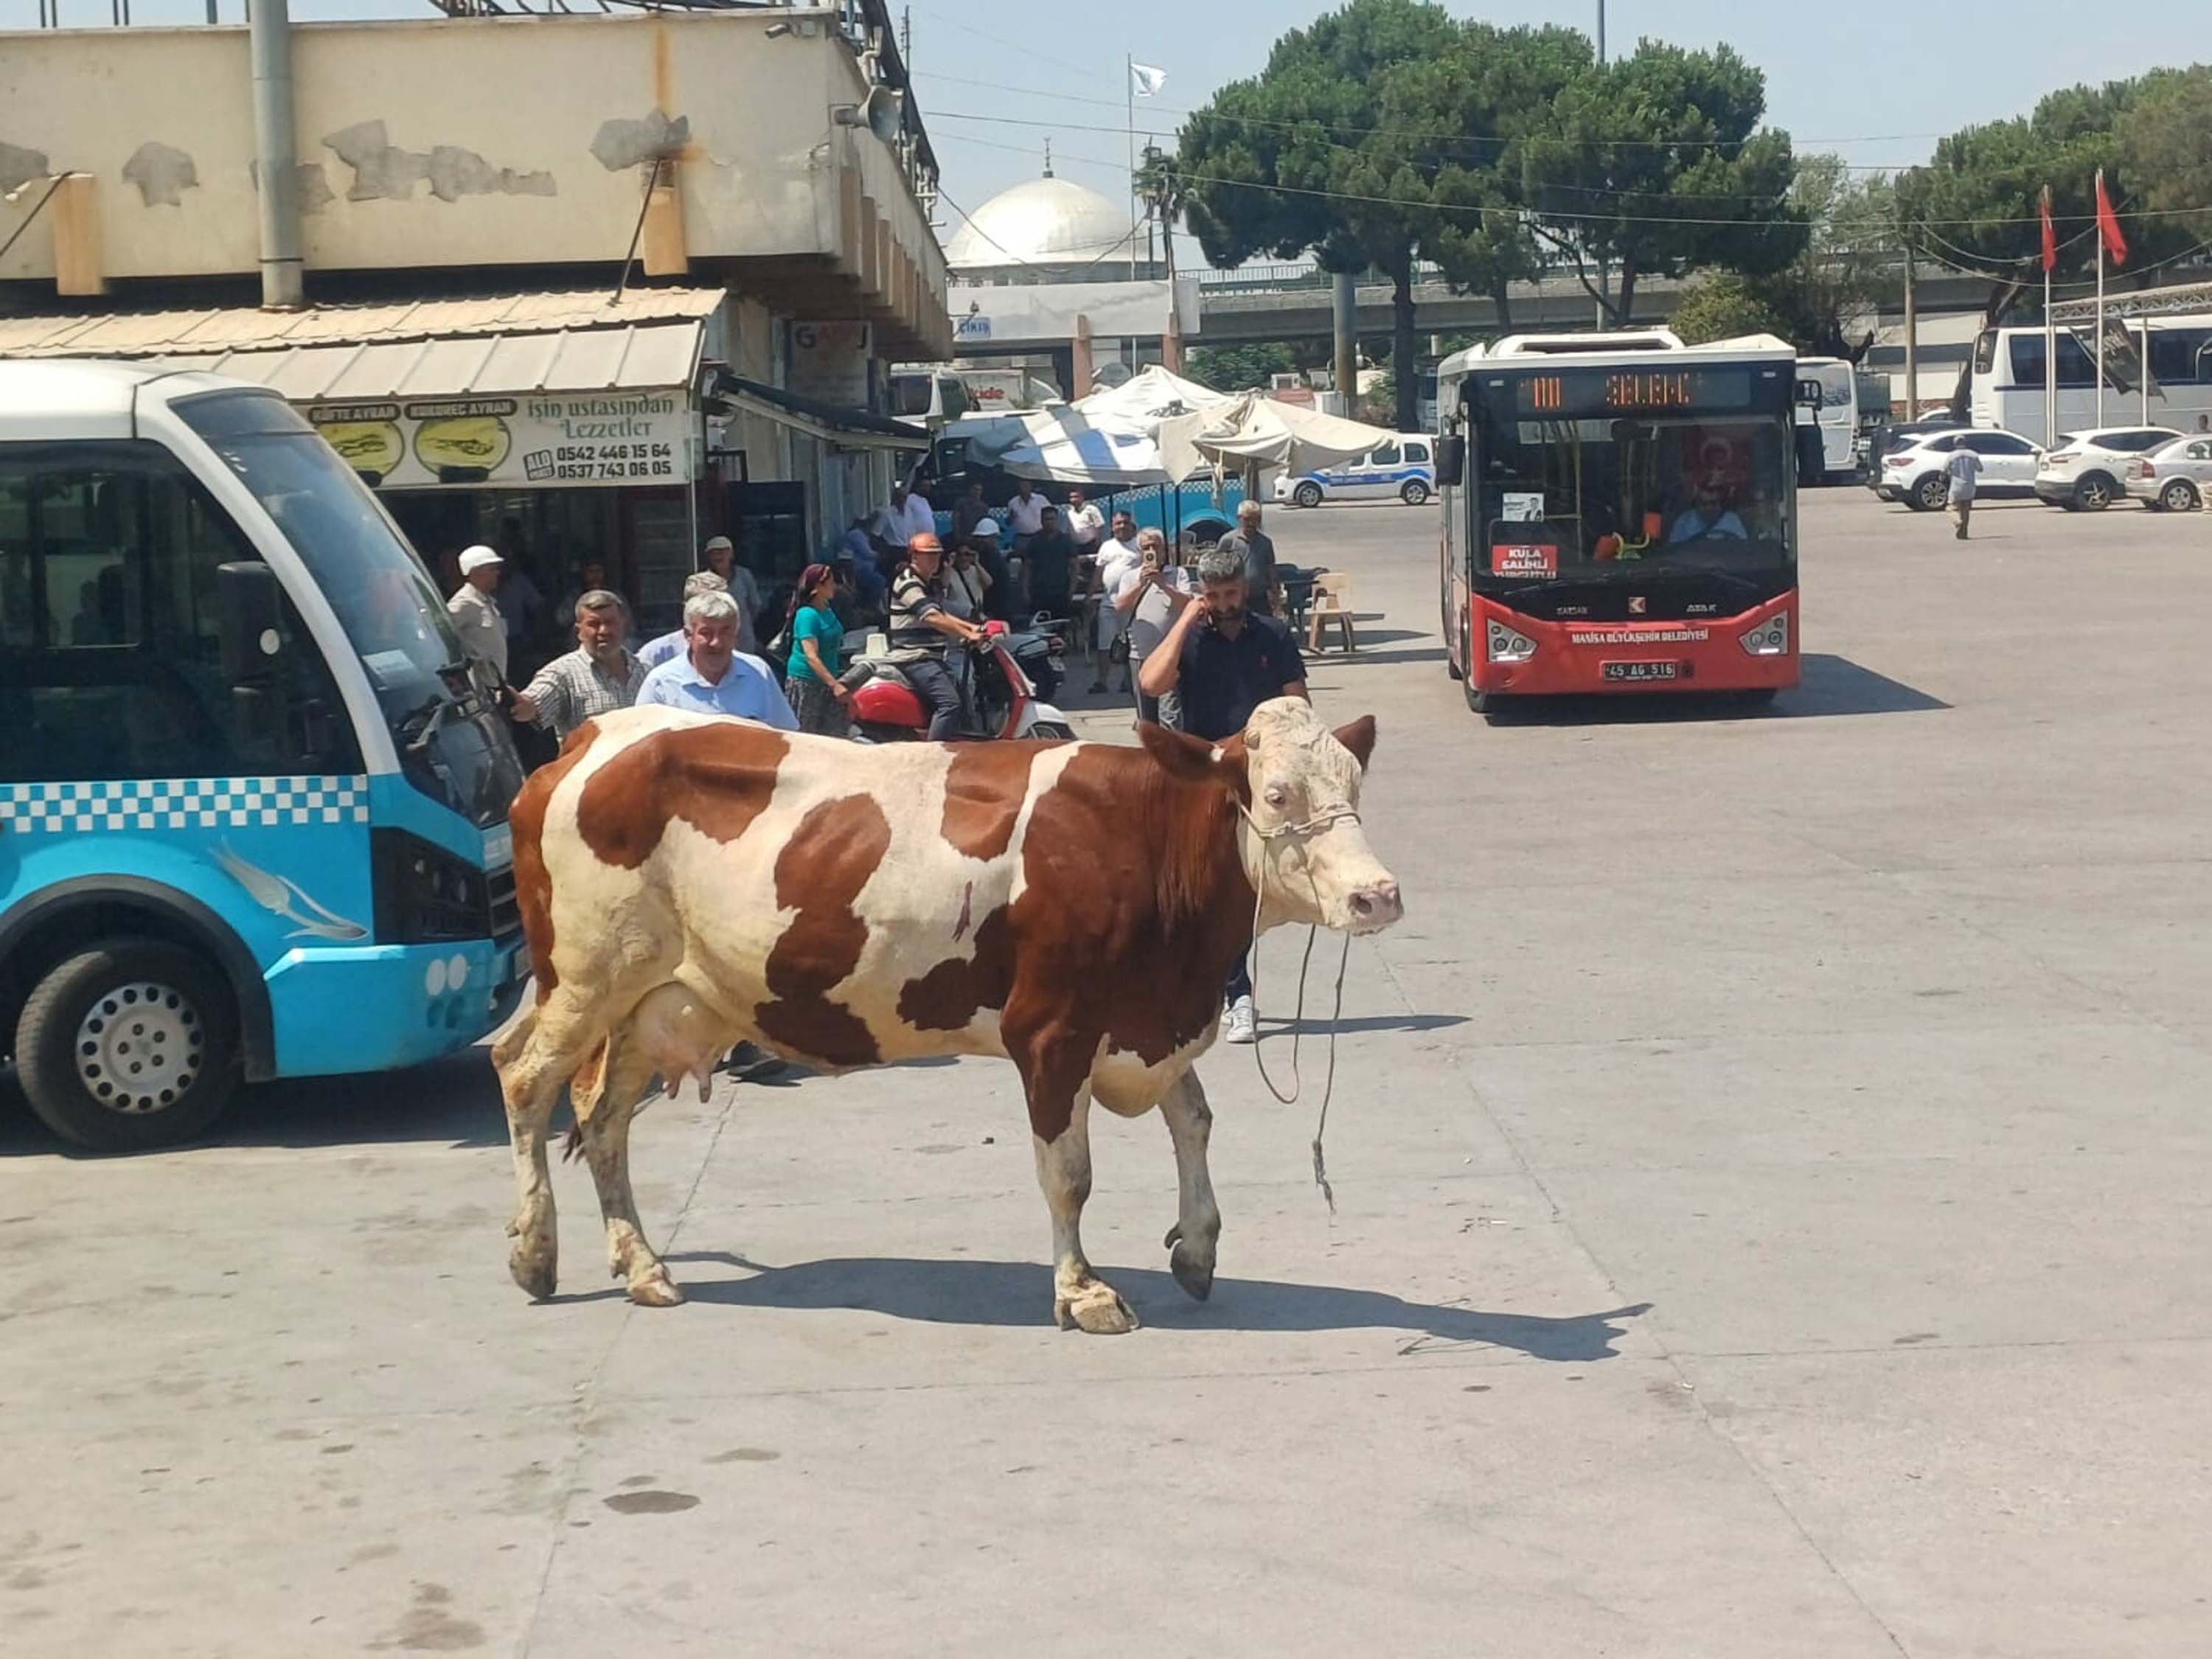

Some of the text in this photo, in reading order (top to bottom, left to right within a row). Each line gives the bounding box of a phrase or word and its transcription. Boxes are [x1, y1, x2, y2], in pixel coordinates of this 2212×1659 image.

[557, 443, 671, 461] 0542 446 15 64
[557, 464, 594, 479] 0537
[598, 462, 625, 477] 743
[629, 462, 647, 476] 06
[652, 461, 671, 475] 05
[1509, 549, 1542, 558] KULA
[1572, 633, 1605, 644] MANİSA
[1661, 629, 1708, 641] BELEDİYESİ
[1610, 665, 1624, 675] 45
[1652, 663, 1672, 674] 516
